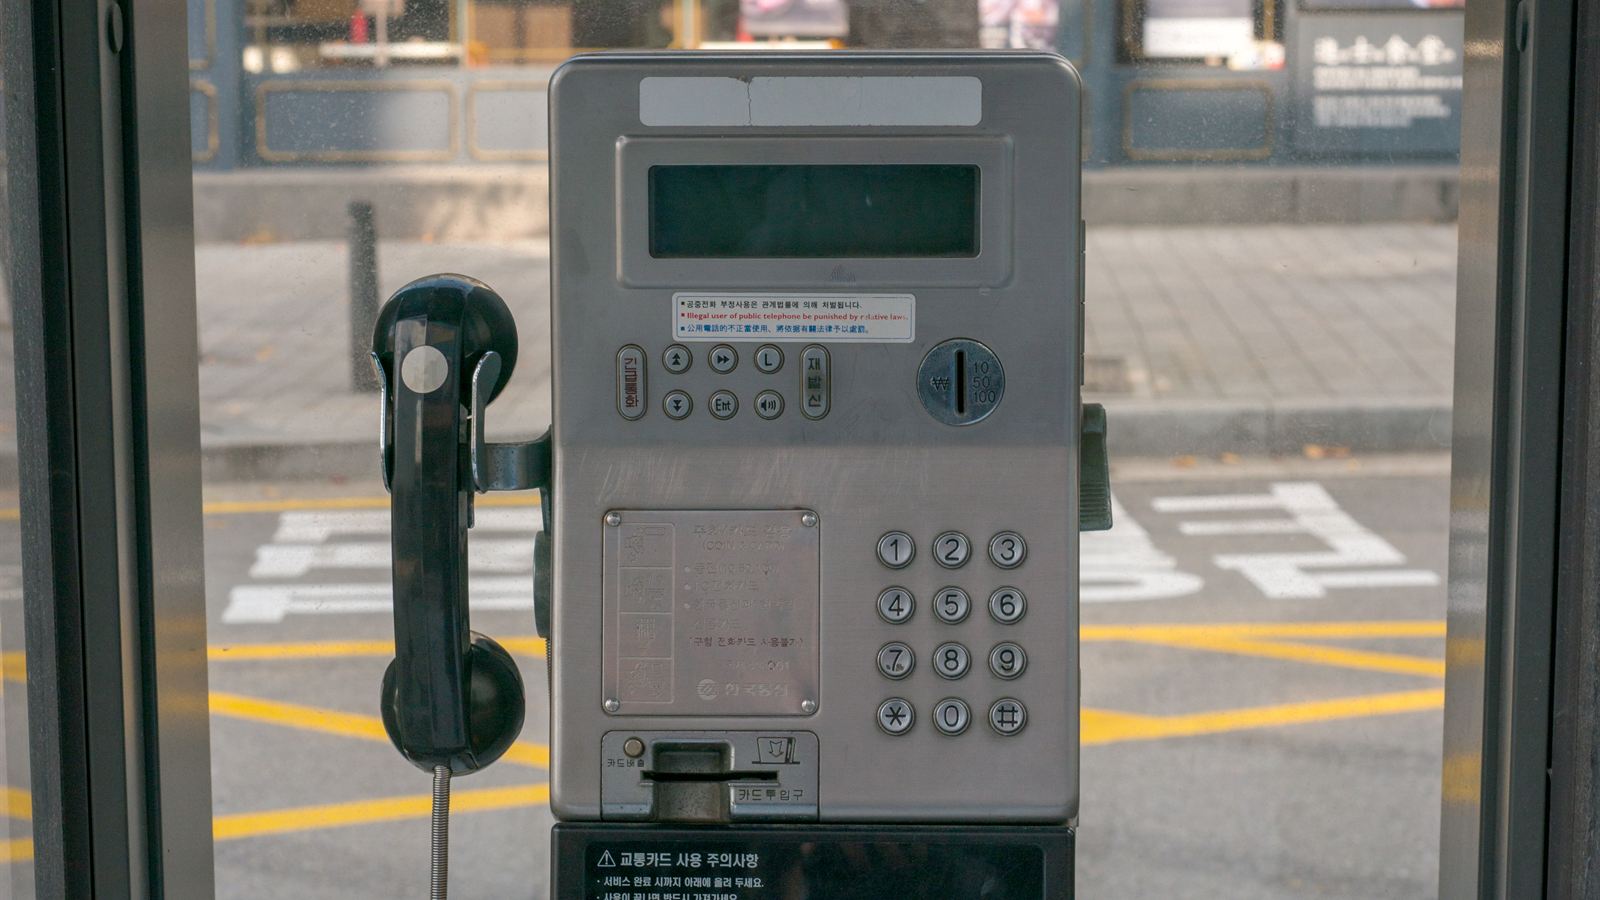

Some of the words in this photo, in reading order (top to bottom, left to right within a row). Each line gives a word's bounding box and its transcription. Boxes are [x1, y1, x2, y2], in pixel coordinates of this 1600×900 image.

[687, 300, 717, 309] 공중전화
[720, 300, 758, 309] 부정사용은
[762, 300, 799, 309] 관계법률에
[803, 301, 818, 309] 의해
[822, 301, 863, 309] 처벌됩니다.
[687, 312, 710, 321] Illegal
[729, 312, 738, 320] of
[739, 312, 761, 321] public
[763, 312, 800, 321] telephone
[802, 312, 812, 320] be
[813, 312, 848, 321] punished
[849, 312, 858, 321] by
[764, 353, 773, 366] L
[974, 361, 989, 374] 10
[973, 376, 990, 389] 50
[974, 390, 996, 403] 100
[715, 398, 731, 411] Ent
[890, 539, 899, 561] 1
[944, 538, 960, 561] 2
[1000, 538, 1015, 561] 3
[888, 594, 904, 617] 4
[944, 594, 959, 616] 5
[1000, 593, 1015, 616] 6
[889, 649, 903, 672] 7
[944, 649, 959, 671] 8
[1000, 649, 1015, 672] 9
[944, 705, 959, 727] 0
[738, 789, 804, 801] 카드투입구
[620, 852, 672, 867] 교통카드
[676, 852, 702, 868] 사용
[706, 853, 759, 869] 주의사항
[603, 876, 631, 887] 서비스
[633, 876, 652, 887] 완료
[654, 876, 681, 887] 시까지
[684, 877, 711, 888] 아래에
[714, 877, 732, 888] 올려
[735, 877, 765, 888] 두세요.
